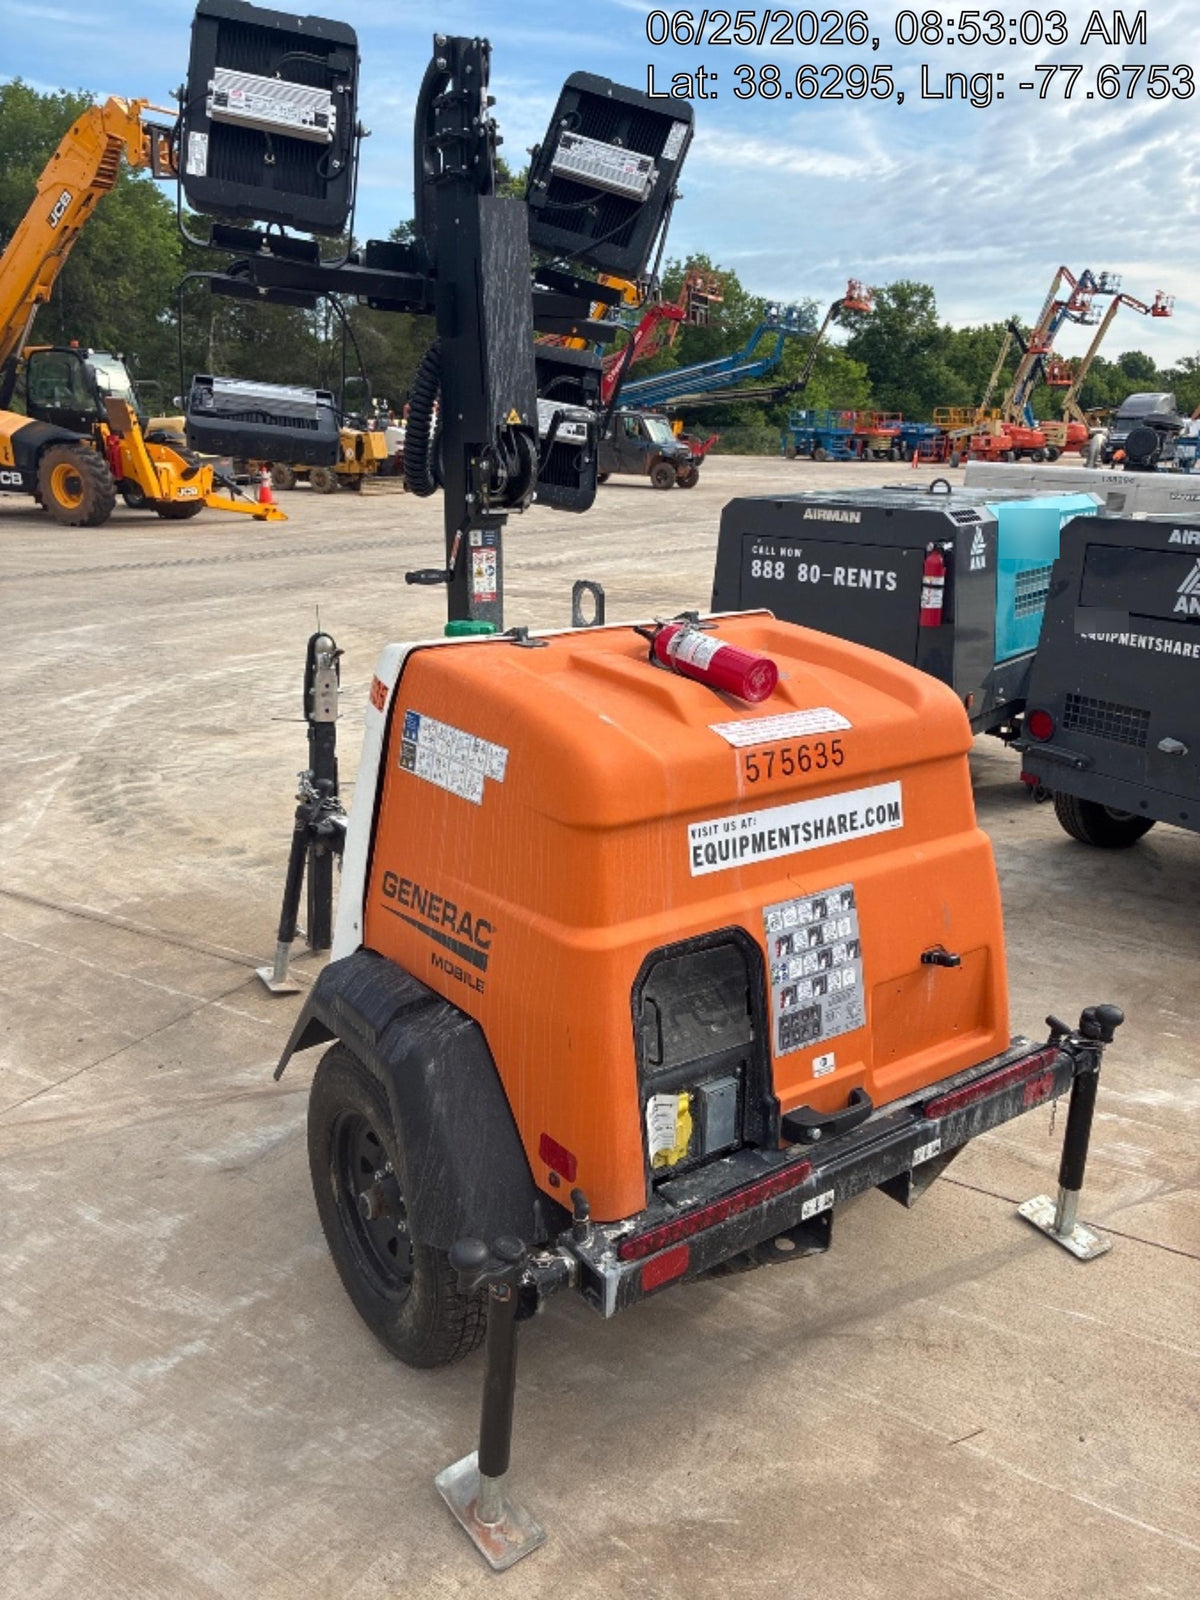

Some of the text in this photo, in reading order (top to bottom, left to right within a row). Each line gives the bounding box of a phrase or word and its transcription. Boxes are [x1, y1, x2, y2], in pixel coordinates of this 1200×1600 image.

[50, 191, 71, 228] JCB
[803, 508, 862, 523] AIRMAN
[752, 545, 802, 557] CALL NOW
[751, 559, 897, 591] 888 80-RENTS
[745, 739, 845, 782] 575635
[691, 817, 757, 840] VISIT US AT:
[692, 801, 900, 867] EQUIPMENTSHARE.COM
[382, 870, 492, 950] GENERAC
[431, 952, 485, 994] MOBILE
